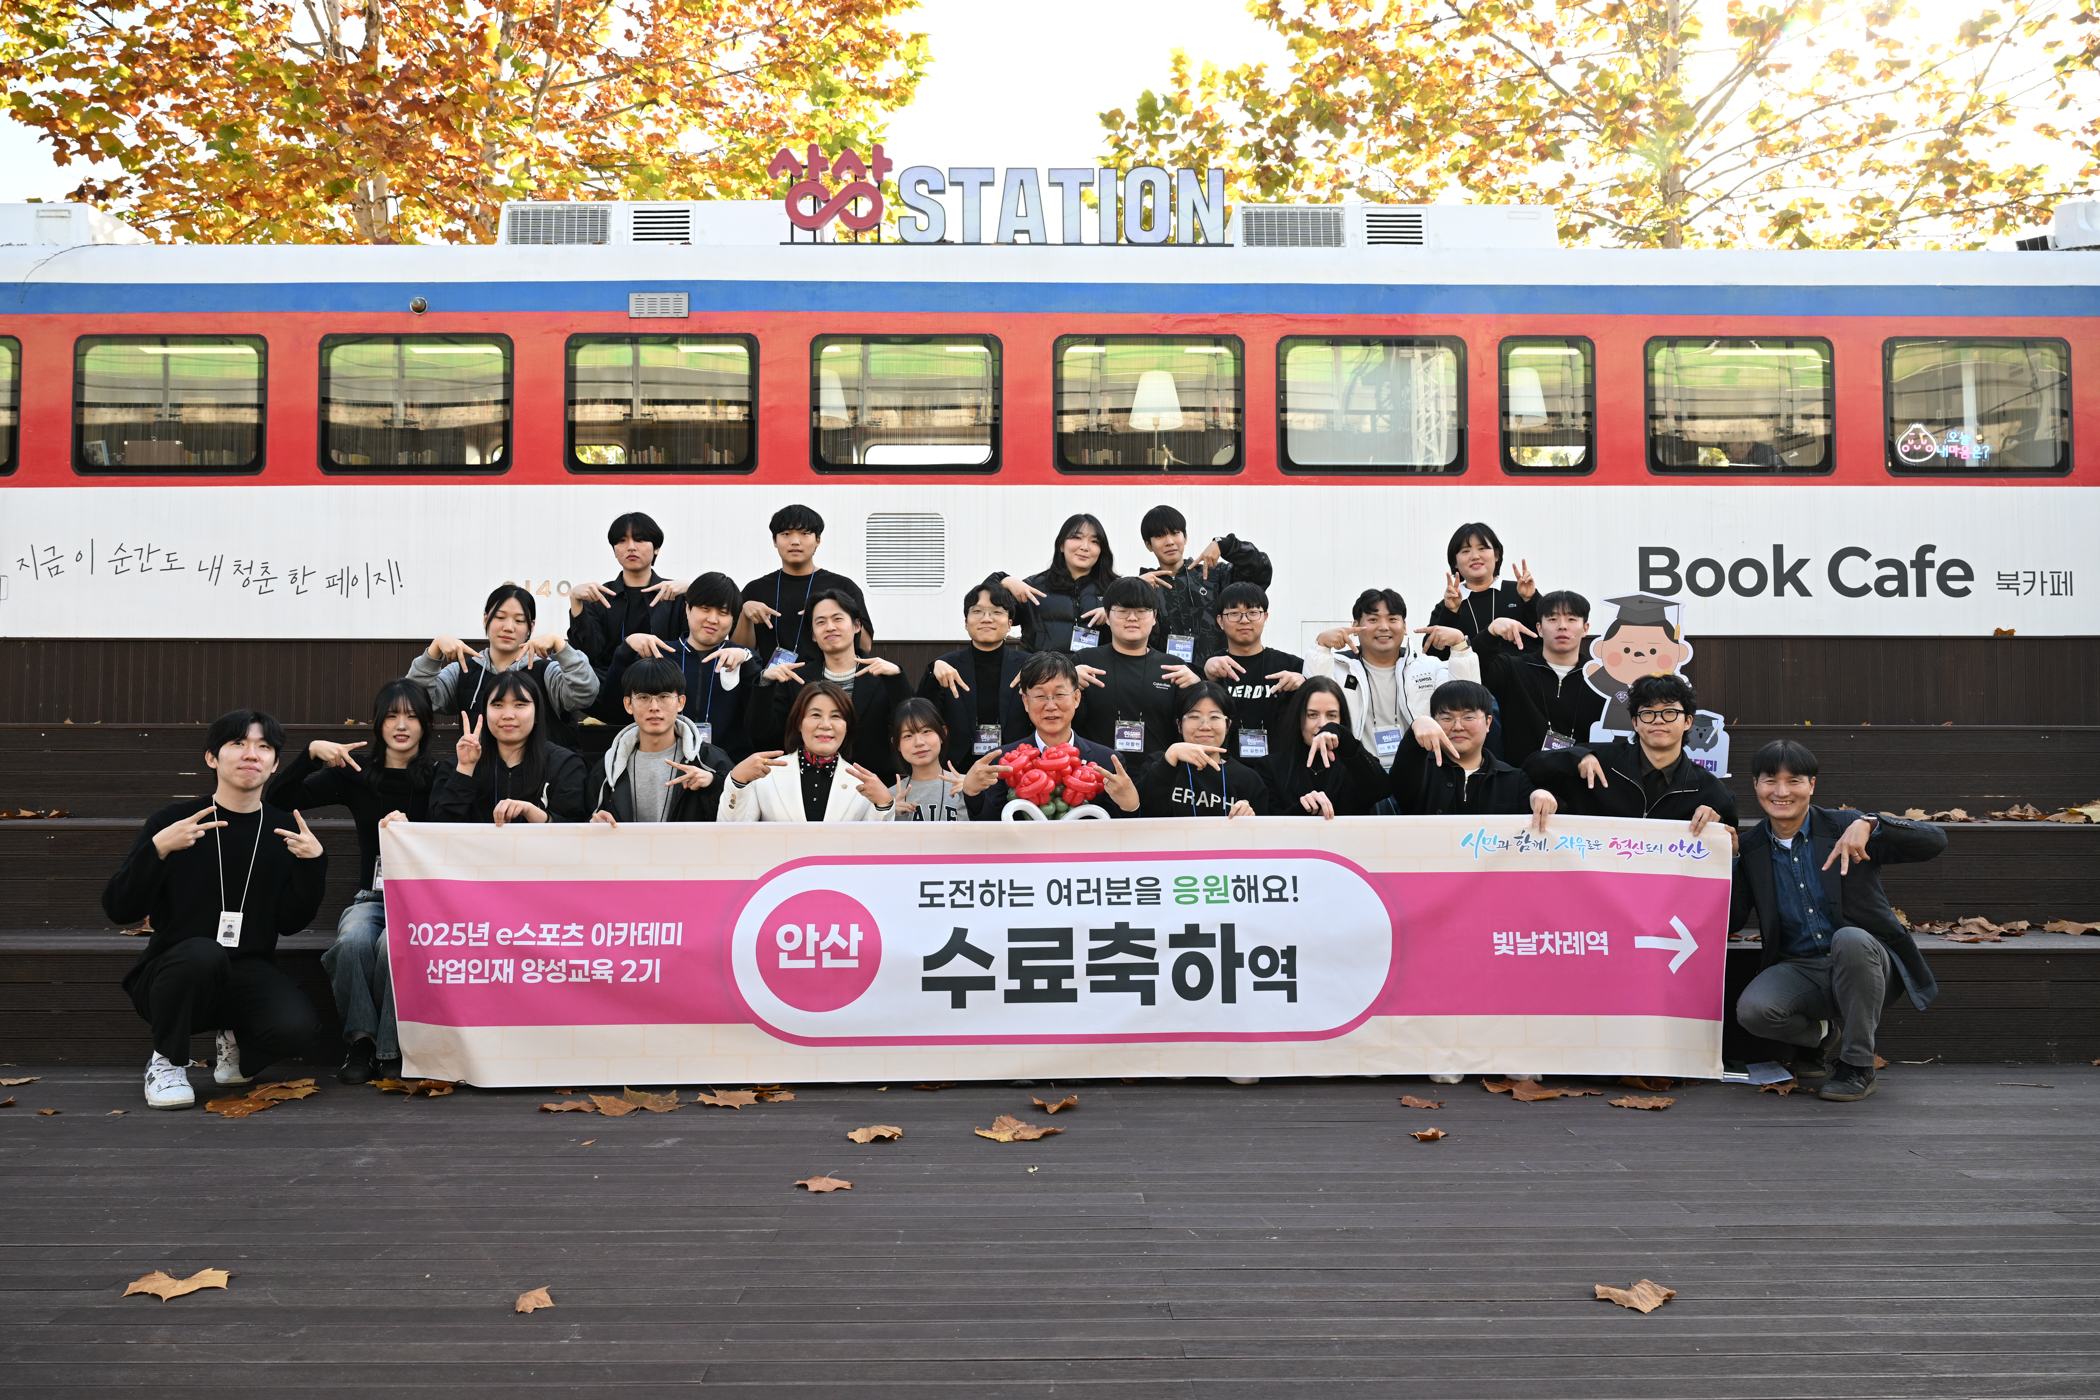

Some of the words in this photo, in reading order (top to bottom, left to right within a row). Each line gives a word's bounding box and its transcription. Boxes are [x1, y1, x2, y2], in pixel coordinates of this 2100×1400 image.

[767, 144, 893, 231] 상상
[898, 166, 1224, 243] STATION
[1946, 430, 1971, 446] 오늘
[17, 544, 65, 581] 지금
[75, 538, 94, 575] 이
[108, 543, 186, 576] 순간도
[198, 554, 224, 587] 내
[232, 560, 278, 595] 청춘
[288, 565, 317, 595] 한
[325, 558, 404, 599] 페이지!
[1638, 543, 1813, 598] Book
[1827, 543, 1975, 598] Cafe
[1995, 570, 2074, 597] 북카페
[1460, 828, 1512, 859] 시민과
[1553, 835, 1603, 860] 자유로운
[1608, 836, 1664, 861] 혁신도시
[1668, 838, 1711, 860] 안산
[919, 879, 1035, 909] 도전하는
[1046, 876, 1162, 907] 여러분을
[1173, 874, 1299, 905] 응원해요!
[408, 922, 490, 947] 2025년
[496, 922, 584, 947] e스포츠
[591, 922, 683, 947] 아카데미
[776, 923, 863, 968] 안산
[1493, 931, 1609, 956] 빛날차례역
[427, 958, 515, 984] 산업인재
[521, 958, 614, 983] 양성교육
[620, 958, 661, 983] 2기
[921, 921, 1298, 1009] 수료축하역
